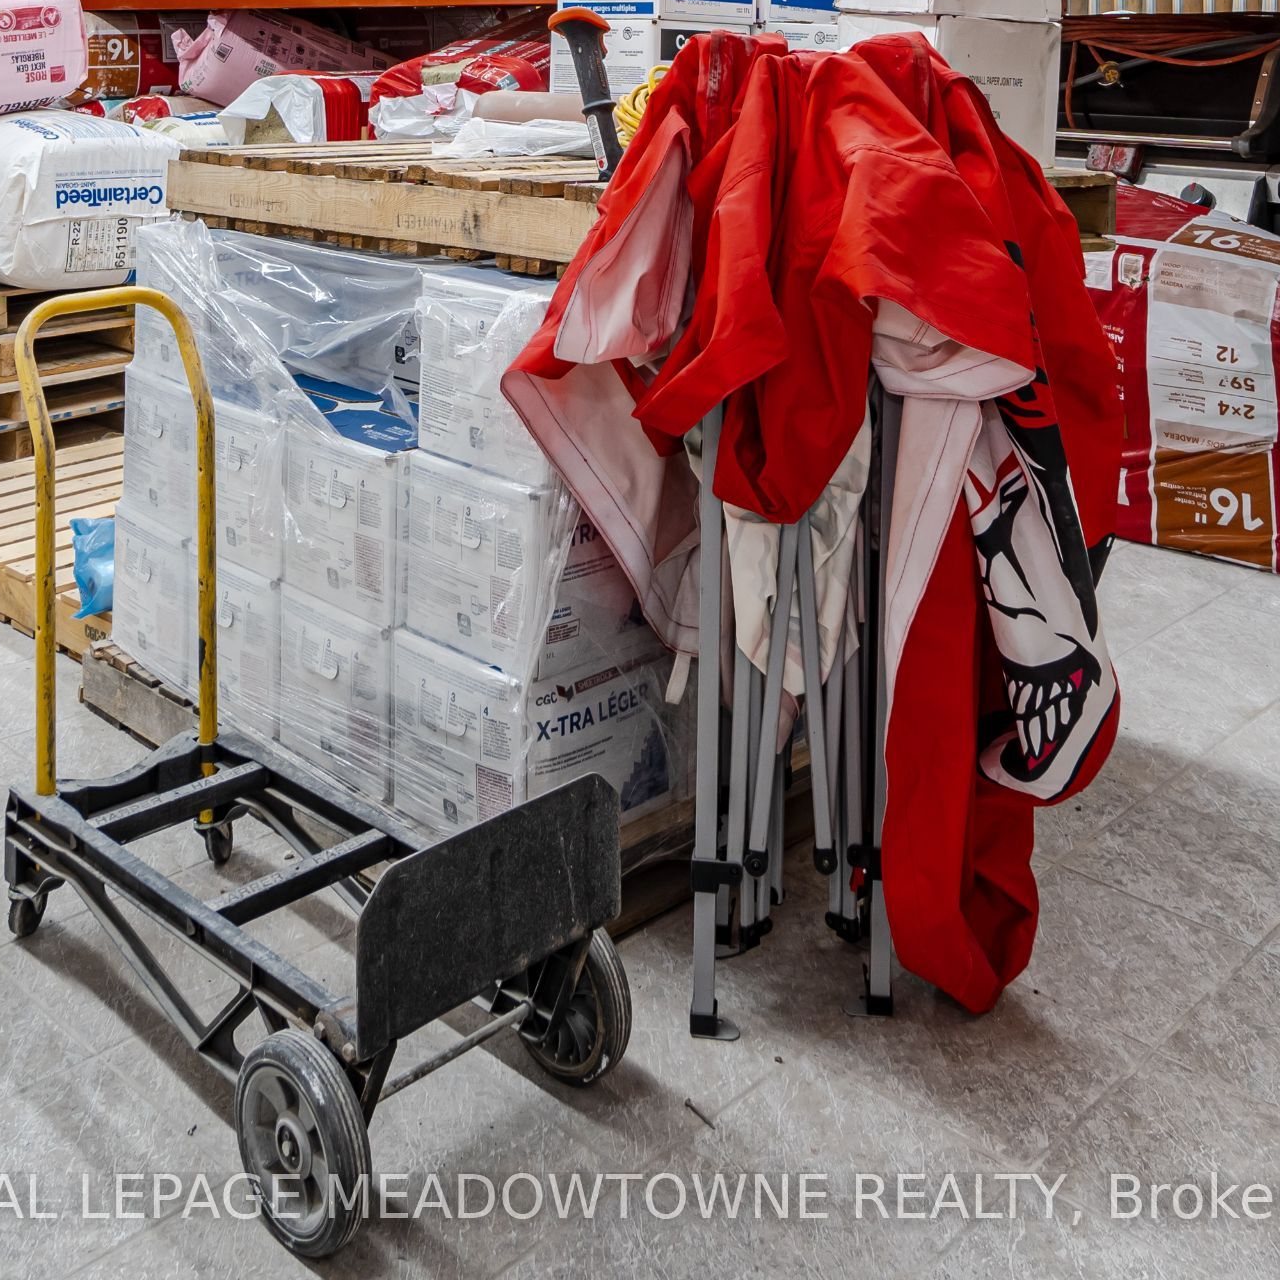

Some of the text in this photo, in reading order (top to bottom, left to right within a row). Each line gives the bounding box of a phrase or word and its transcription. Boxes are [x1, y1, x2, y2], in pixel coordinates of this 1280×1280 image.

[2, 32, 38, 42] MEILLEUR
[11, 52, 46, 64] FIBERGLAS
[15, 62, 47, 73] NEXT GEN
[24, 70, 48, 84] ROSE
[986, 75, 1023, 88] PAPER JOINT TAPE
[56, 184, 163, 210] CertainTeed
[69, 220, 82, 247] R-22
[114, 217, 129, 270] 651190
[1160, 279, 1184, 290] MADERA
[1216, 345, 1239, 365] 12
[1163, 430, 1200, 444] MADERA
[1196, 500, 1208, 509] On
[465, 506, 472, 517] 3
[449, 692, 456, 704] 3
[536, 690, 558, 707] CGC
[483, 706, 489, 717] 4
[536, 682, 651, 743] X-TRA LÉGER
